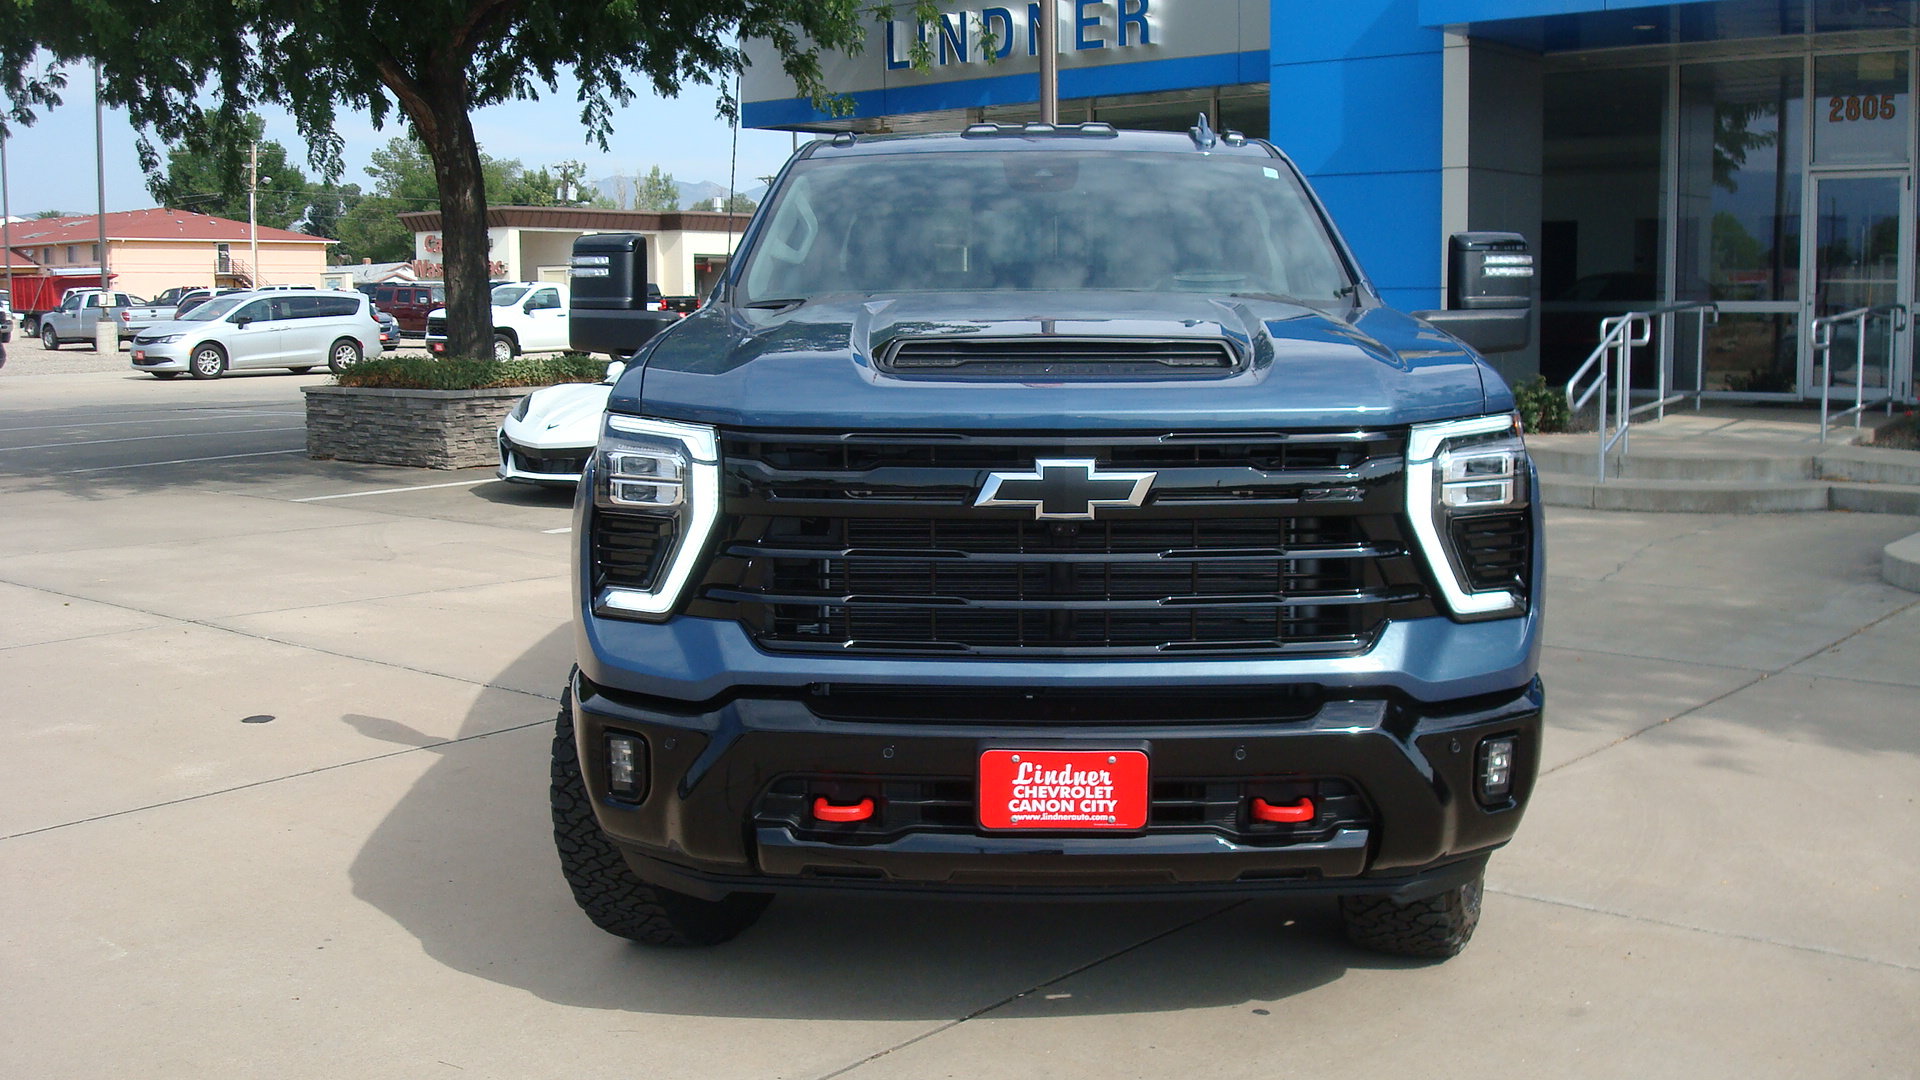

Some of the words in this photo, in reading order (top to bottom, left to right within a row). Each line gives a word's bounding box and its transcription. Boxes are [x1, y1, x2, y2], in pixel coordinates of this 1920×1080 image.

[1829, 95, 1895, 123] 2805
[1012, 762, 1112, 786] Lindner
[1013, 785, 1114, 799] CHEVROLET
[1008, 799, 1074, 813] CANON
[1080, 799, 1117, 813] CITY
[1016, 812, 1109, 821] www.lindnerauto.com
